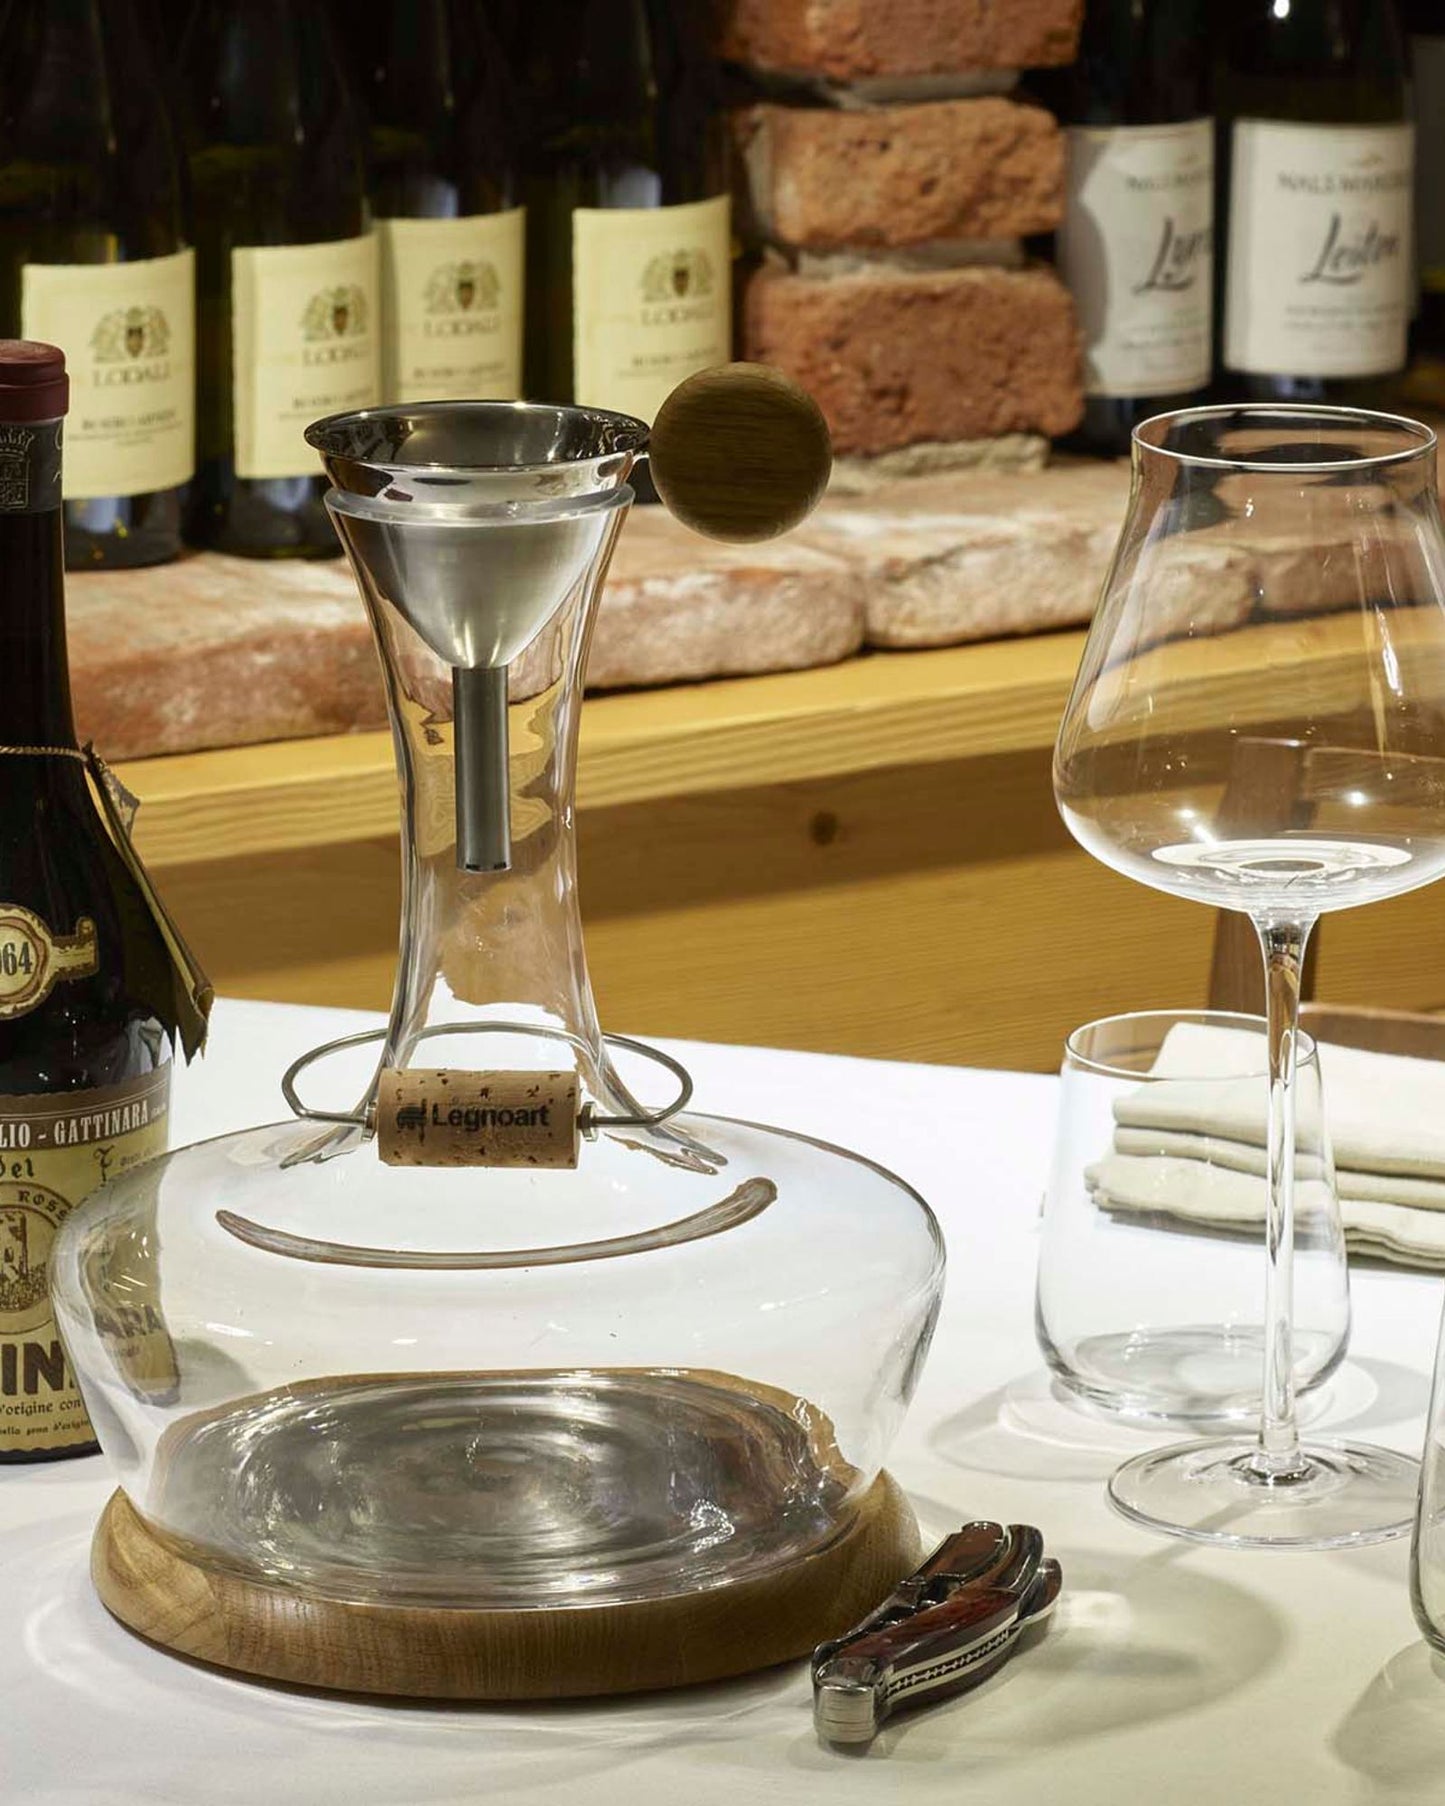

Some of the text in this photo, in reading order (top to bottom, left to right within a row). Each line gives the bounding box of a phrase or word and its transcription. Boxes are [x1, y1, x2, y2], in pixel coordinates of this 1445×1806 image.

[0, 942, 33, 976] 64
[54, 1099, 149, 1145] GATTINARA
[432, 1103, 549, 1132] Legnoart
[1, 1340, 75, 1396] IN
[0, 1402, 54, 1417] 'origine
